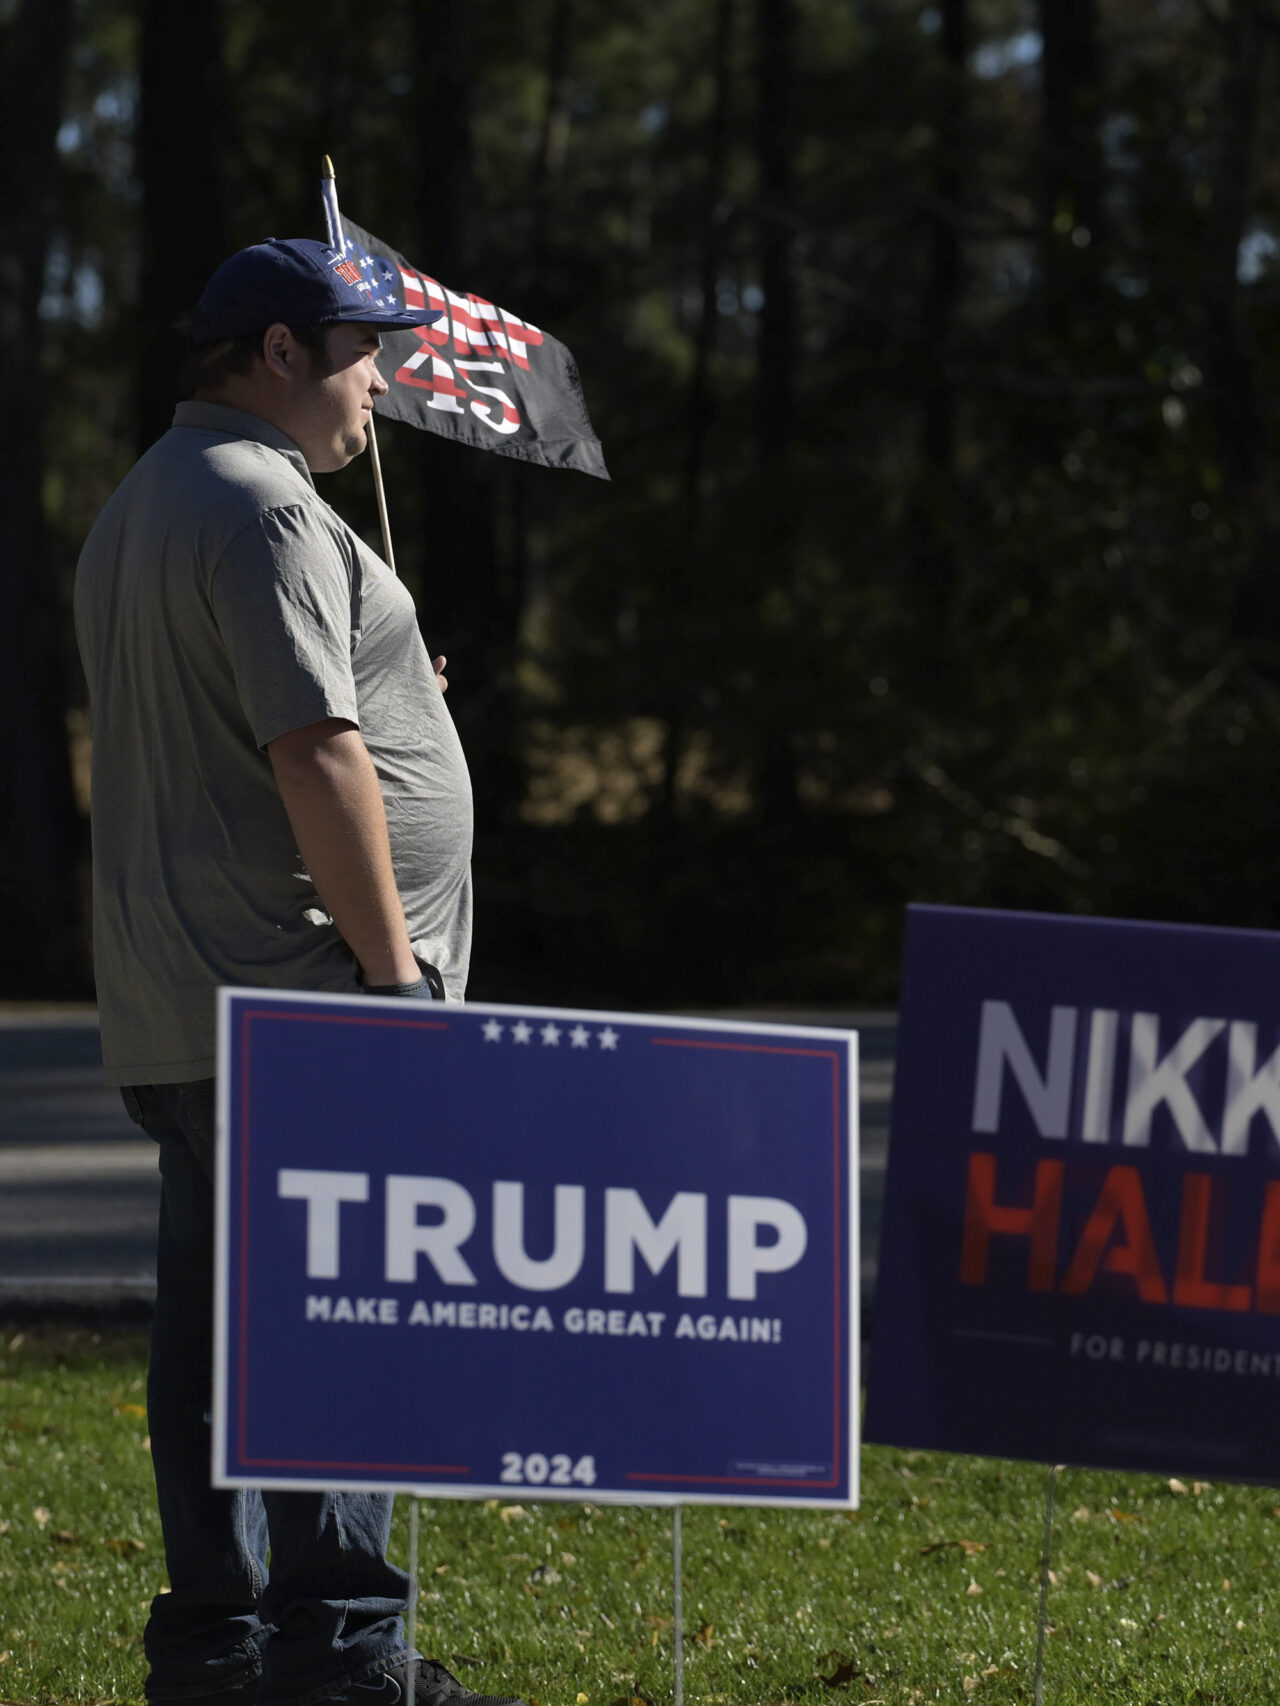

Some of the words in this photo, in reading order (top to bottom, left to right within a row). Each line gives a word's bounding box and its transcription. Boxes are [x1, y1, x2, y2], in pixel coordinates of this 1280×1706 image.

[395, 342, 521, 434] 45
[278, 1169, 808, 1300] TRUMP
[306, 1295, 399, 1325] MAKE
[408, 1302, 553, 1333] AMERICA
[564, 1308, 665, 1338] GREAT
[676, 1314, 783, 1344] AGAIN!
[1070, 1333, 1124, 1361] FOR
[501, 1452, 597, 1486] 2024
